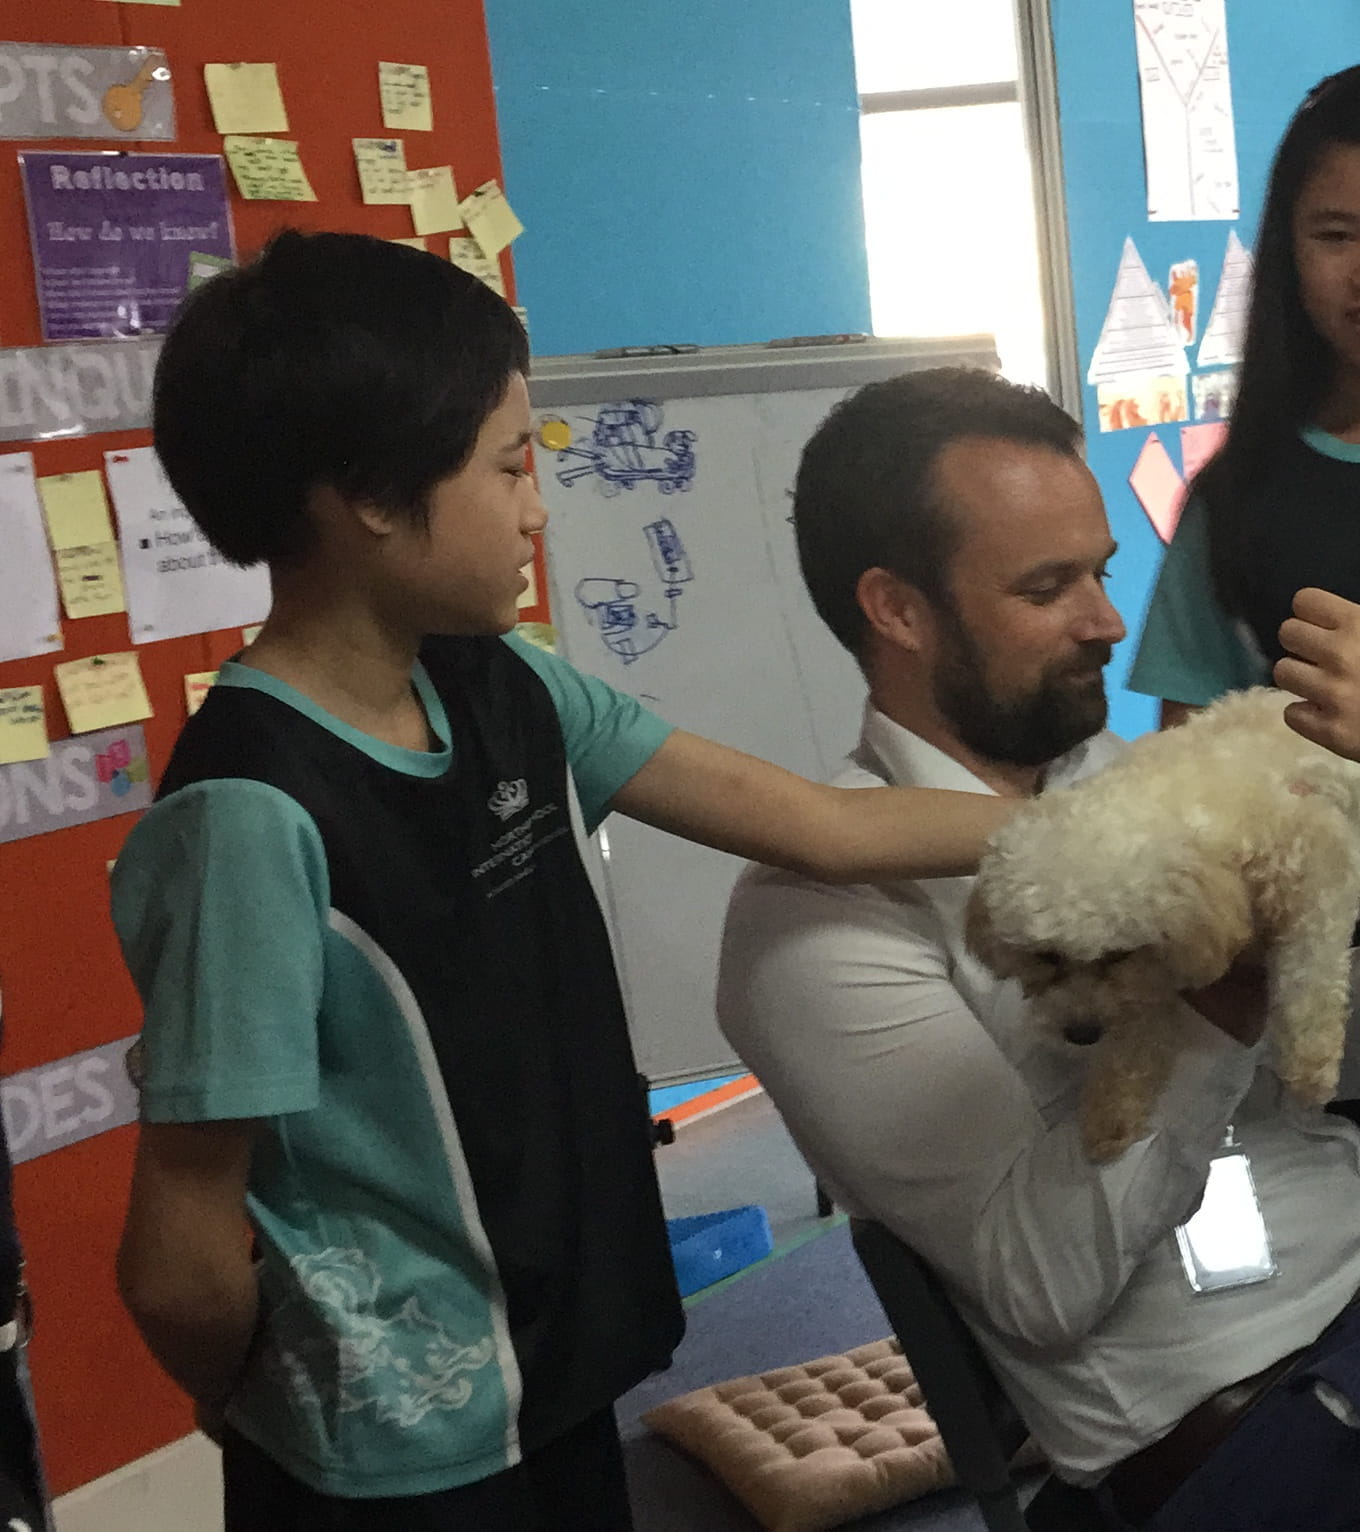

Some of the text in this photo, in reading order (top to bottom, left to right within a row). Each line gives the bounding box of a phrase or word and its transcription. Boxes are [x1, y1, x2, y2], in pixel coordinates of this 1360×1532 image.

[49, 164, 206, 192] Reflection
[47, 220, 92, 242] How
[98, 219, 123, 242] do
[155, 531, 193, 547] How
